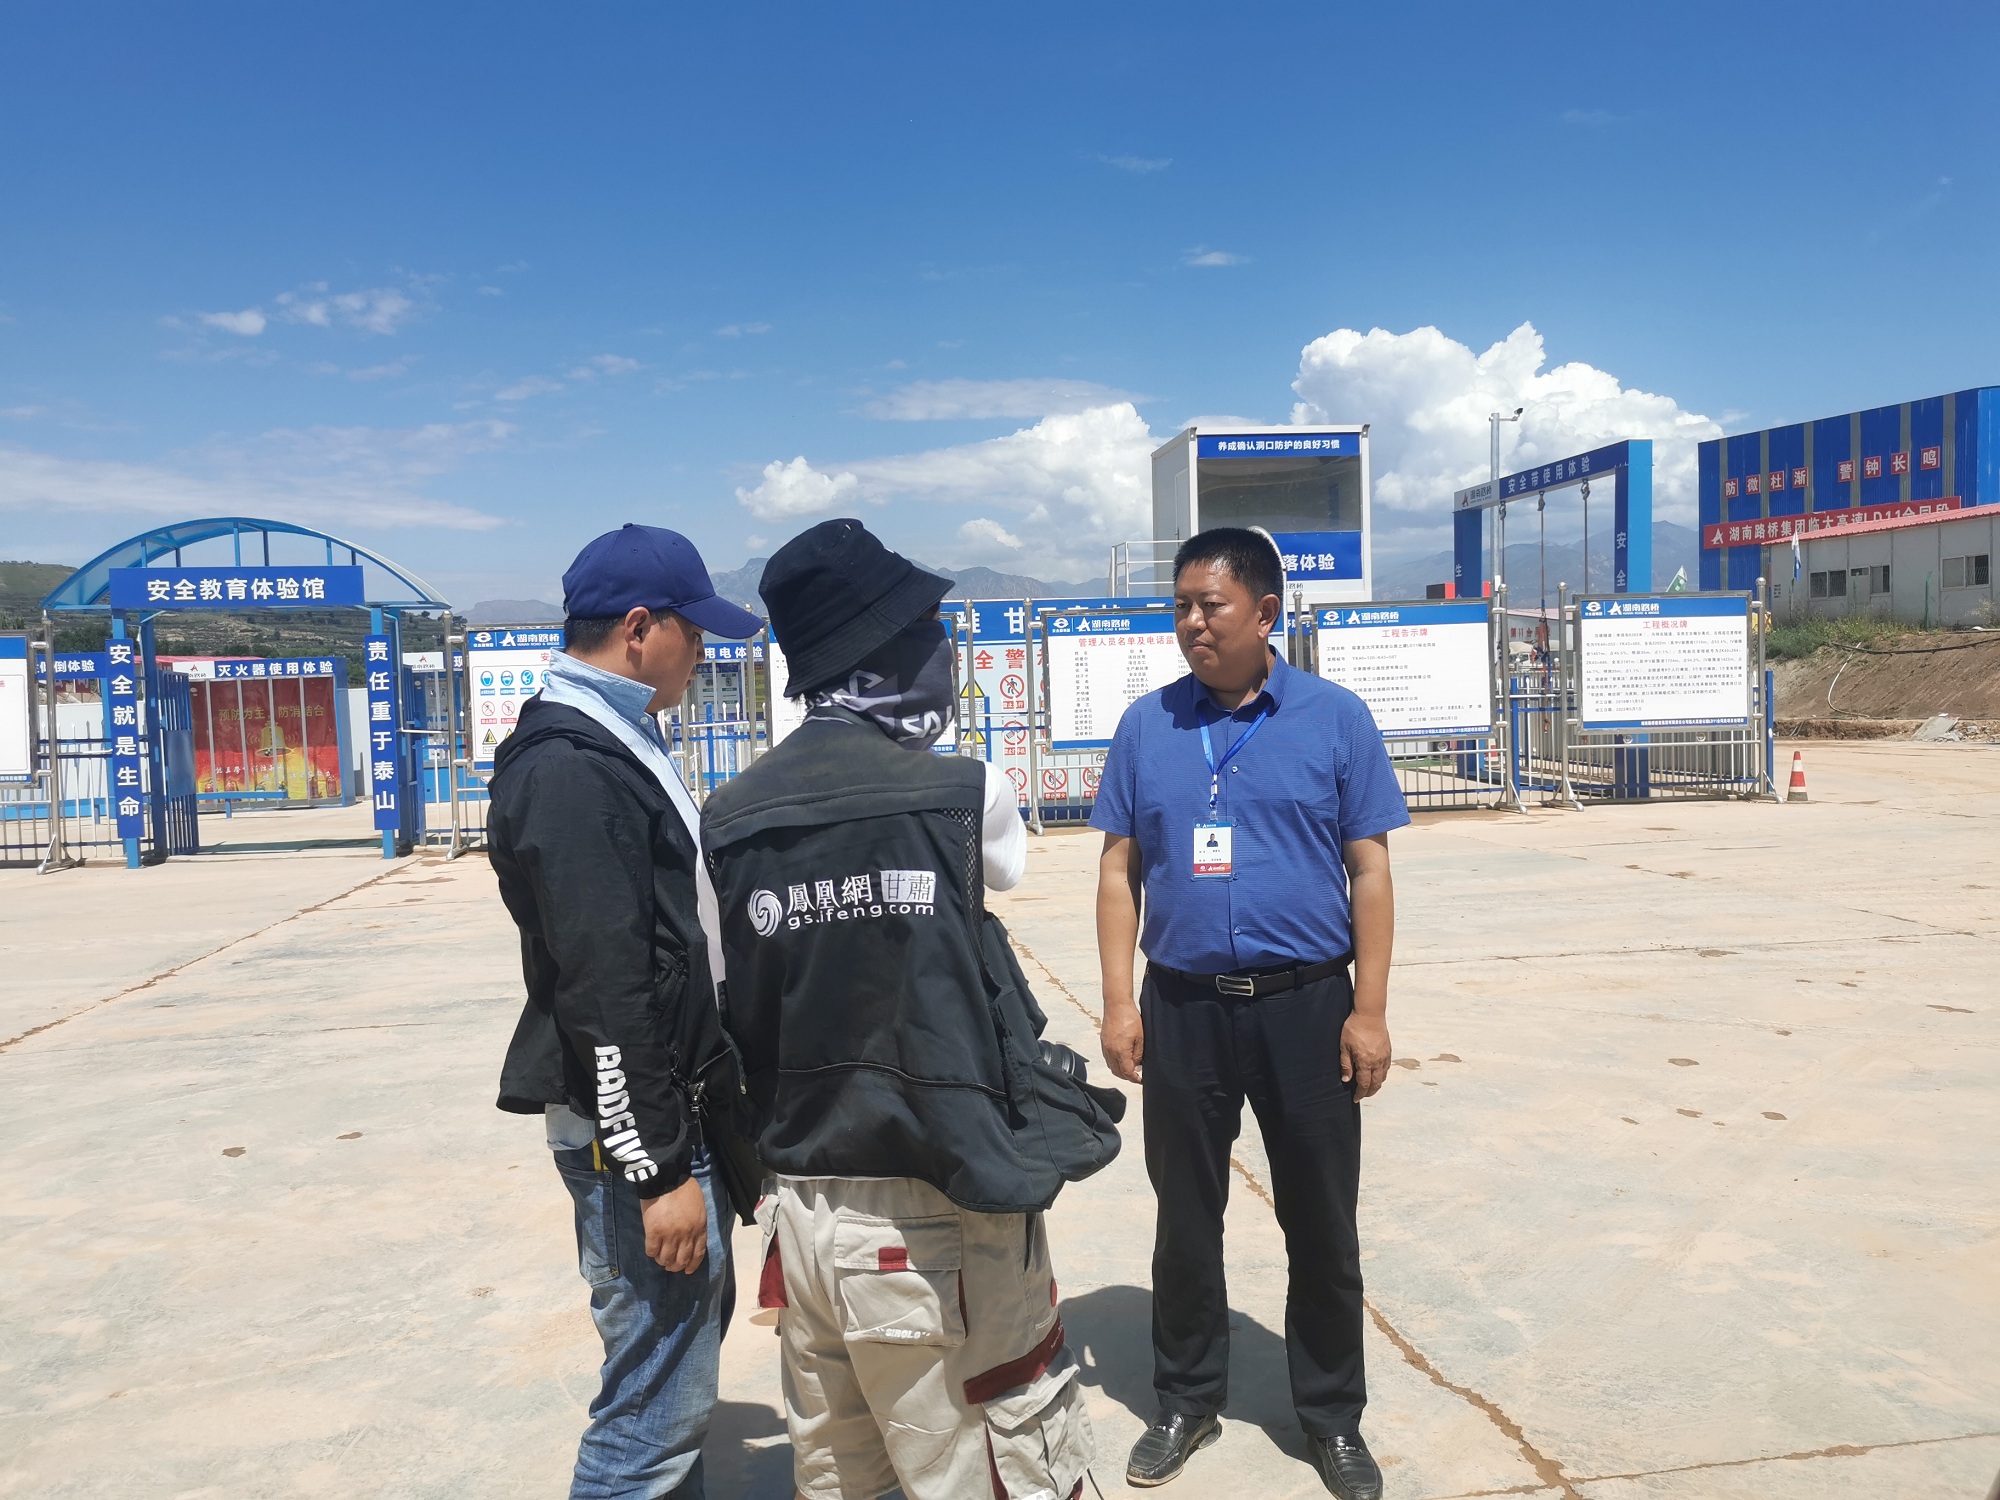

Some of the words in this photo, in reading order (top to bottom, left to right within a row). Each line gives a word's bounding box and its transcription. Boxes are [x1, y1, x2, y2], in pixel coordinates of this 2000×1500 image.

[1218, 439, 1340, 451] 养成确认洞口防护的良好习惯
[1507, 455, 1590, 493] 安全带使用体验
[1725, 469, 1807, 496] 防微杜渐
[1839, 449, 1937, 480] 警钟长鸣
[147, 577, 326, 601] 安全教育体验馆
[1382, 628, 1428, 638] 工程告示牌
[1643, 620, 1688, 629] 工程概况牌
[517, 634, 560, 643] 湖南路桥
[1078, 635, 1179, 647] 管理人员名单及电话监
[217, 661, 334, 677] 灭火器使用体验
[109, 644, 140, 818] 安全就是生命
[368, 641, 396, 811] 责任重于泰山
[787, 874, 873, 916] 鳳凰網
[788, 903, 934, 929] gs.ifeng.com
[595, 1045, 659, 1183] BADFIVE
